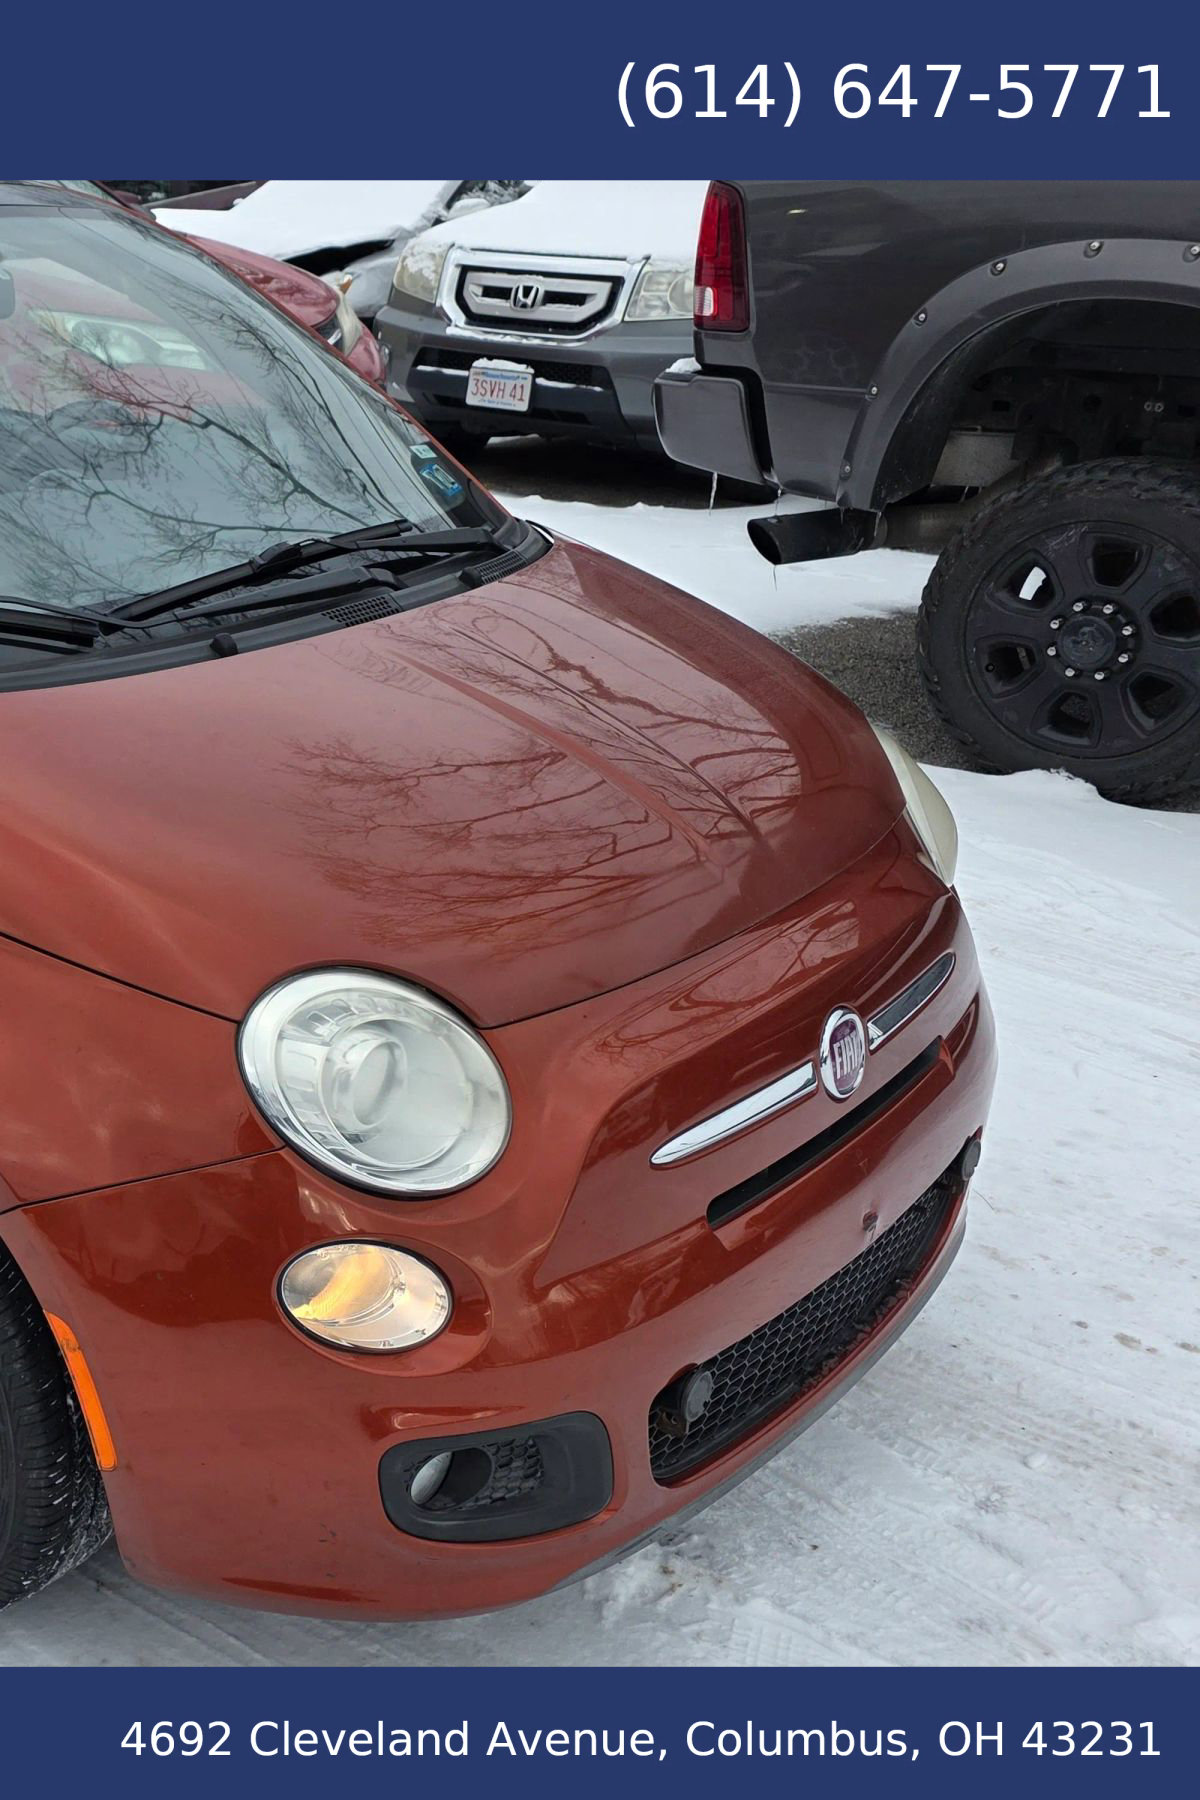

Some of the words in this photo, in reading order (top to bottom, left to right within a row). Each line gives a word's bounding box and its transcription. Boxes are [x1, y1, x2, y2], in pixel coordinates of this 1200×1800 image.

[470, 377, 506, 399] 3SVH
[509, 383, 525, 402] 41
[832, 1028, 861, 1081] FIAT
